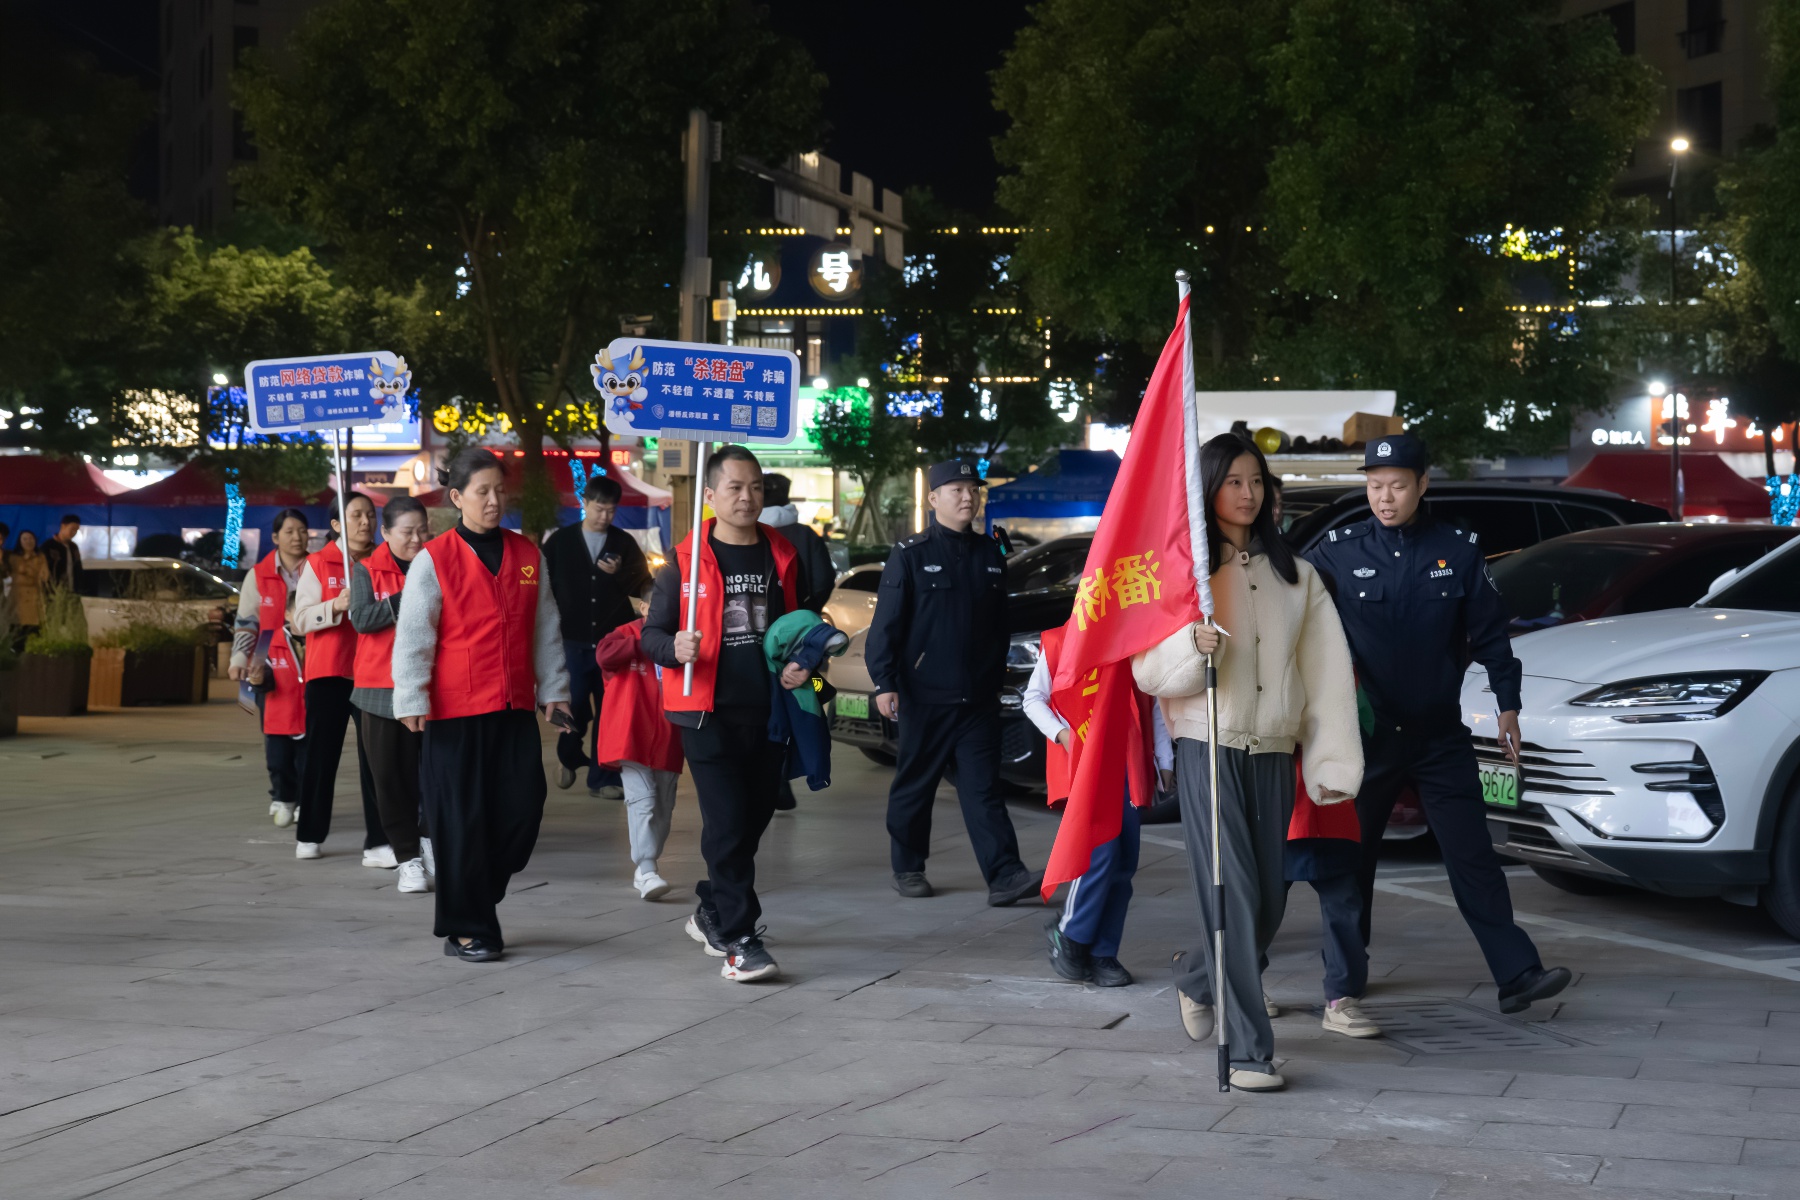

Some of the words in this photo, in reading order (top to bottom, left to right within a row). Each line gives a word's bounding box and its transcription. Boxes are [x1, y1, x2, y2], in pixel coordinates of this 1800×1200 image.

[258, 365, 365, 388] 防范网络贷款诈骗
[652, 361, 676, 377] 防范
[684, 356, 755, 383] “杀猪盘”
[762, 369, 785, 385] 诈骗
[661, 384, 694, 397] 不轻信
[702, 387, 735, 400] 不透露
[743, 390, 776, 402] 不转账
[725, 574, 763, 584] NOSEY
[1479, 770, 1515, 800] 9672
